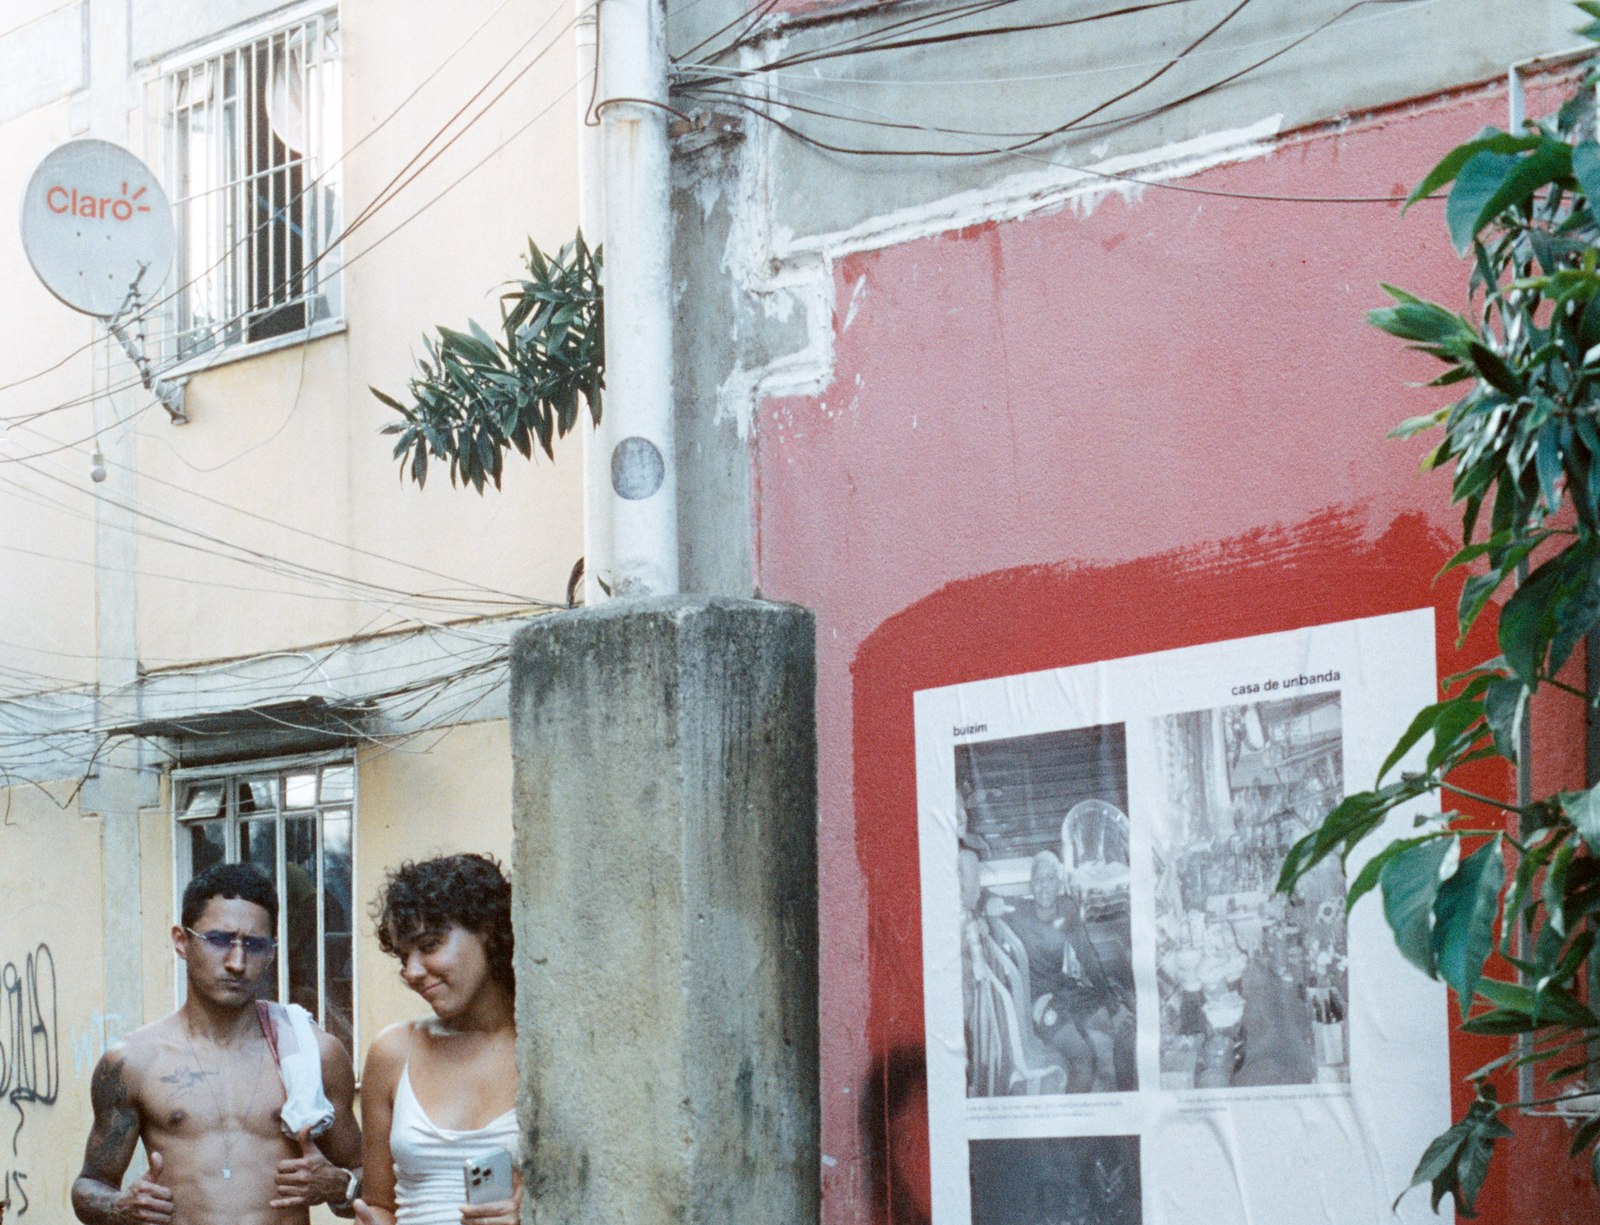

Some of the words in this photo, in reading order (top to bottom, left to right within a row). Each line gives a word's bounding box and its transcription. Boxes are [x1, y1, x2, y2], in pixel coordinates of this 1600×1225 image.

[47, 184, 133, 221] Claro
[1231, 683, 1260, 696] casa
[1263, 679, 1280, 692] de
